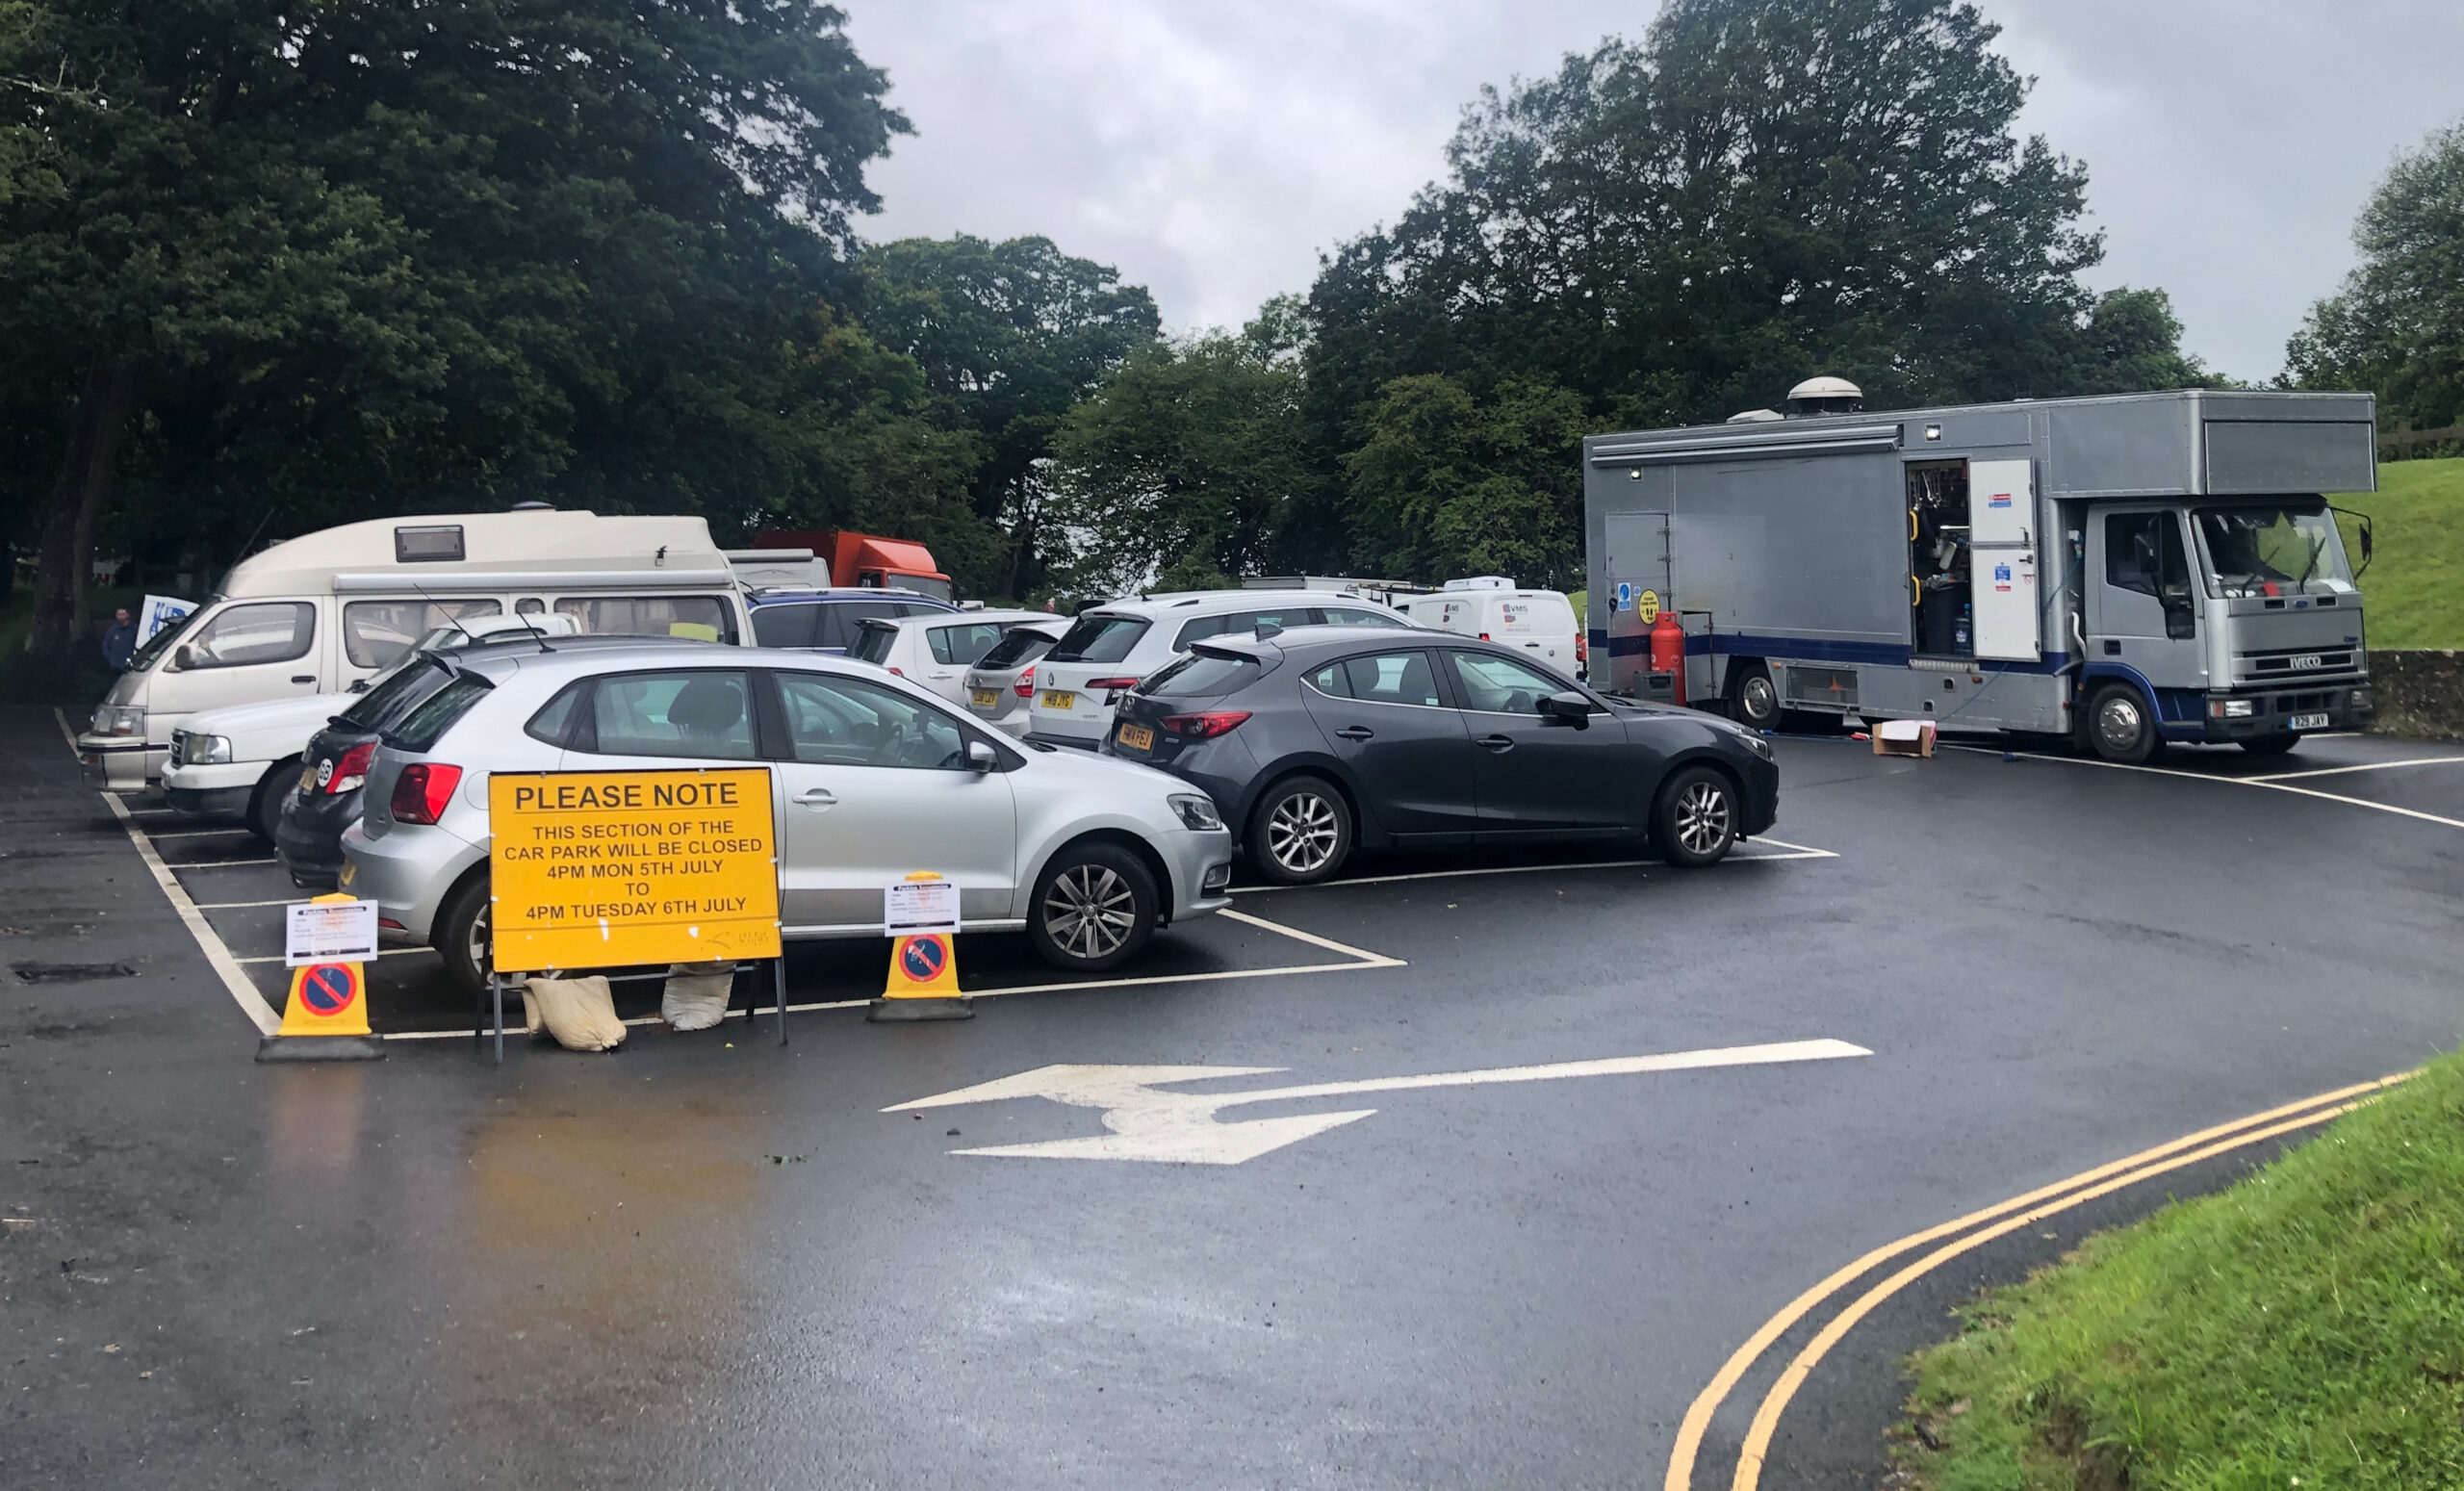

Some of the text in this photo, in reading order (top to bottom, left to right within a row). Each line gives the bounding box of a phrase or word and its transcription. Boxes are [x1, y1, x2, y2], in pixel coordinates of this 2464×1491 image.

[2291, 656, 2322, 670] IVECO
[2295, 713, 2326, 730] R29 JAY
[515, 782, 738, 810] PLEASE NOTE
[533, 820, 733, 840] THIS SECTION OF THE
[504, 838, 762, 861] CAR PARK WILL BE CLOSED
[547, 860, 724, 879] 4PM MON 5TH JULY
[626, 882, 650, 896] TO
[526, 897, 747, 919] 4PM TUESDAY 6TH JULY
